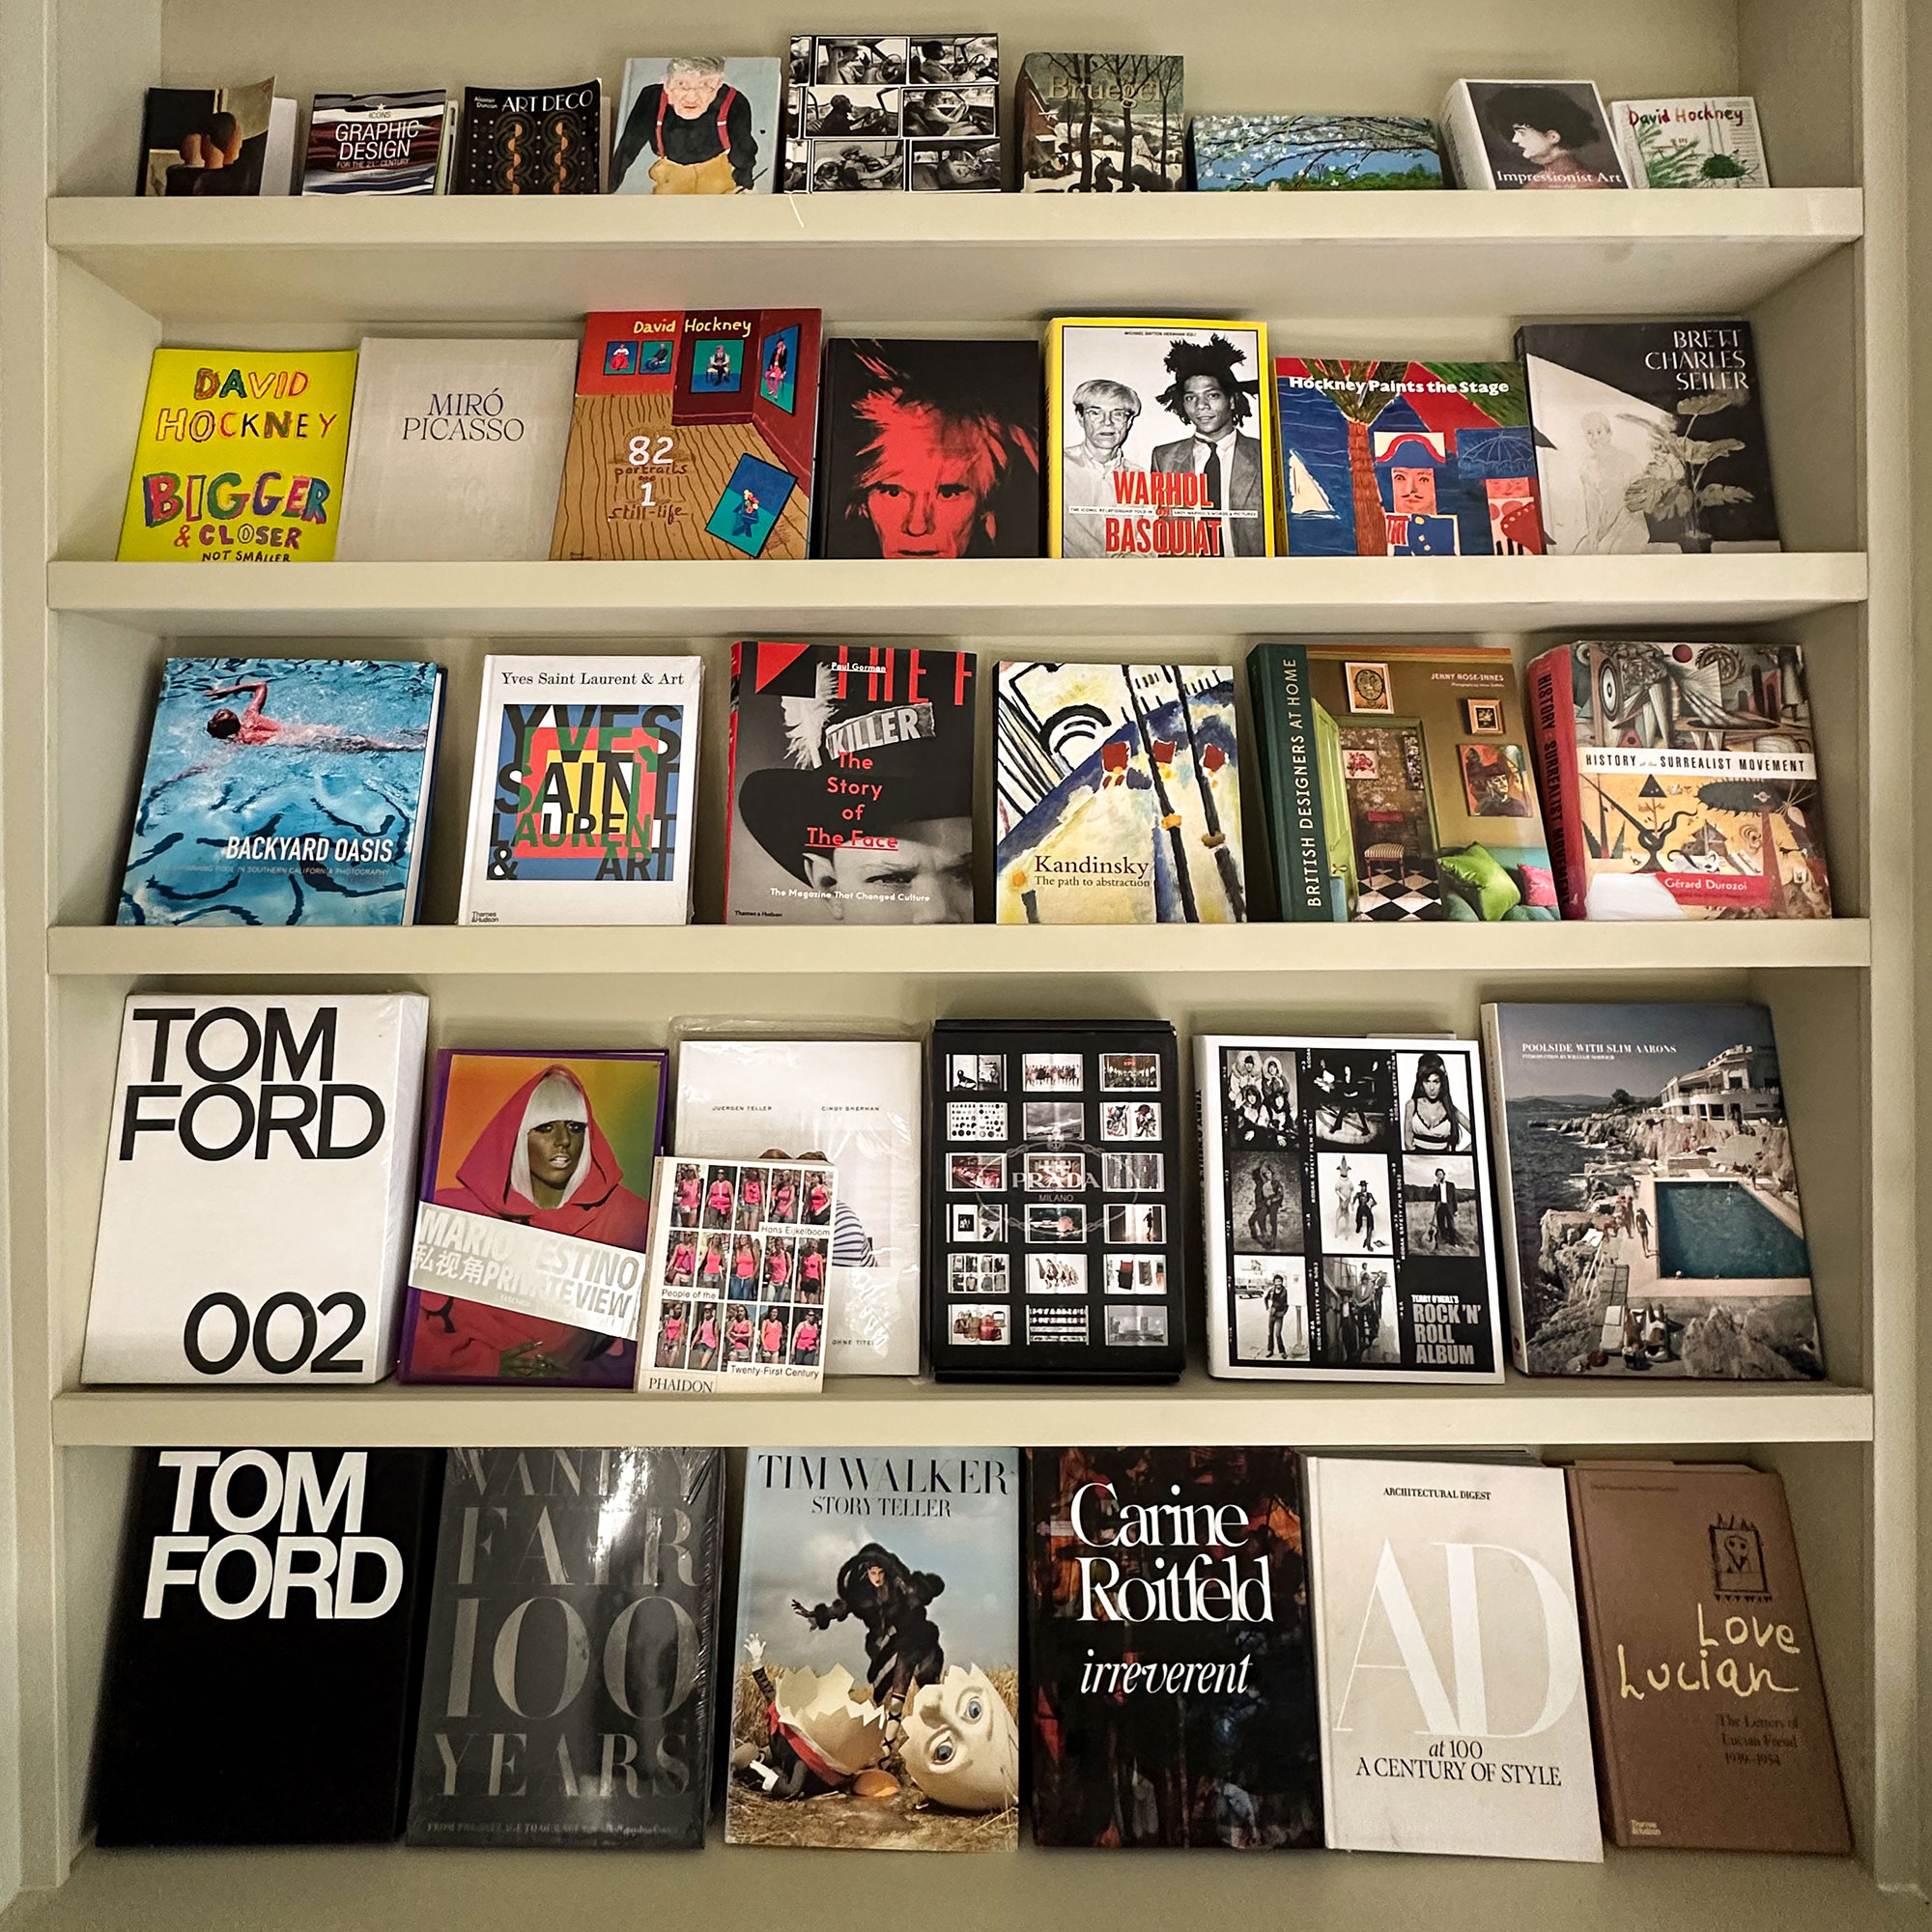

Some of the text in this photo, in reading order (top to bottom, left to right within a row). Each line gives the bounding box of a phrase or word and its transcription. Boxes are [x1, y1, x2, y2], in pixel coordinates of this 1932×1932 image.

[502, 89, 594, 112] ART DECO
[1048, 76, 1162, 109] Bruegel
[1629, 104, 1744, 128] David Hockney
[335, 120, 420, 142] GRAPHIC
[339, 139, 411, 160] DESIGN
[380, 157, 411, 167] CENTURY
[1496, 170, 1623, 184] Impressionist Art
[633, 316, 753, 338] David Hockney
[1645, 350, 1746, 370] CHARLES
[193, 368, 309, 400] DAVID
[1289, 375, 1509, 396] Hockney Paints the Stage
[427, 387, 504, 417] MIRÓ
[155, 408, 338, 443] HOCKNEY
[402, 417, 525, 442] PICASSO
[628, 435, 675, 466] 82
[614, 462, 688, 483] portraits
[142, 470, 331, 528] BIGGER
[640, 482, 657, 507] 1
[1113, 470, 1214, 509] WARHOL
[608, 504, 689, 525] still-life
[174, 523, 303, 550] & CLOSER
[1105, 517, 1222, 557] BASQUIAT
[201, 550, 292, 562] NOT SMALLER
[502, 671, 684, 685] Yves Saint Laurent & Art
[831, 662, 886, 673] Paul Gorman
[1538, 673, 1555, 731] HISTORY
[503, 704, 682, 765] YVES
[829, 708, 921, 760] KILLER
[838, 753, 874, 769] The
[1586, 753, 1805, 772] HISTORY SURREALIST MOVEMENT
[496, 756, 681, 814] SAINT
[827, 776, 883, 801] Story
[1282, 658, 1322, 907] BRITISH DESIGNERS AT HOME
[1544, 741, 1563, 822] SURREALIST
[841, 804, 865, 820] of
[490, 812, 678, 850] LAURENT
[807, 827, 899, 848] The Face
[226, 836, 394, 863] BACKYARD OASIS
[333, 868, 389, 877] PHOTOGRAPHY
[487, 846, 518, 880] &
[1035, 855, 1150, 880] Kandinsky
[1034, 875, 1151, 888] The path to abstraction
[1664, 877, 1748, 891] Gérard Durozoi
[770, 887, 930, 902] The Magazine That Changed Culture
[132, 1006, 338, 1082] TOM
[1522, 1043, 1677, 1053] POOLSIDE WITH SLIM AARONS
[119, 1083, 385, 1161] FORD
[1012, 1172, 1101, 1188] PRADA
[1038, 1193, 1074, 1202] MILANO
[419, 1208, 511, 1262] MARIO
[761, 1225, 784, 1235] Hans
[661, 1289, 716, 1299] People of the
[1412, 1304, 1481, 1324] ROCK 'N'
[183, 1291, 367, 1375] 002
[1414, 1323, 1455, 1343] ROLL
[1416, 1344, 1475, 1364] ALBUM
[648, 1377, 713, 1392] PHAIDON
[731, 1365, 819, 1379] Twenty-First Century
[757, 1455, 1009, 1495] TIM WALKER
[158, 1449, 368, 1534] TOM
[1383, 1487, 1492, 1500] ARCHITECTURAL DIGEST
[811, 1496, 951, 1518] STORY TELLER
[1070, 1482, 1249, 1548] Carine
[456, 1506, 699, 1586] FAIR
[143, 1534, 404, 1620] FORD
[1075, 1553, 1274, 1622] Roitfeld
[1333, 1537, 1583, 1738] AD
[1698, 1602, 1800, 1654] Love
[1080, 1648, 1253, 1694] irreverent
[1617, 1644, 1799, 1700] Lucian
[1429, 1739, 1483, 1758] at 100
[434, 1733, 692, 1798] YEARS
[1356, 1757, 1562, 1787] A CENTURY OF STYLE
